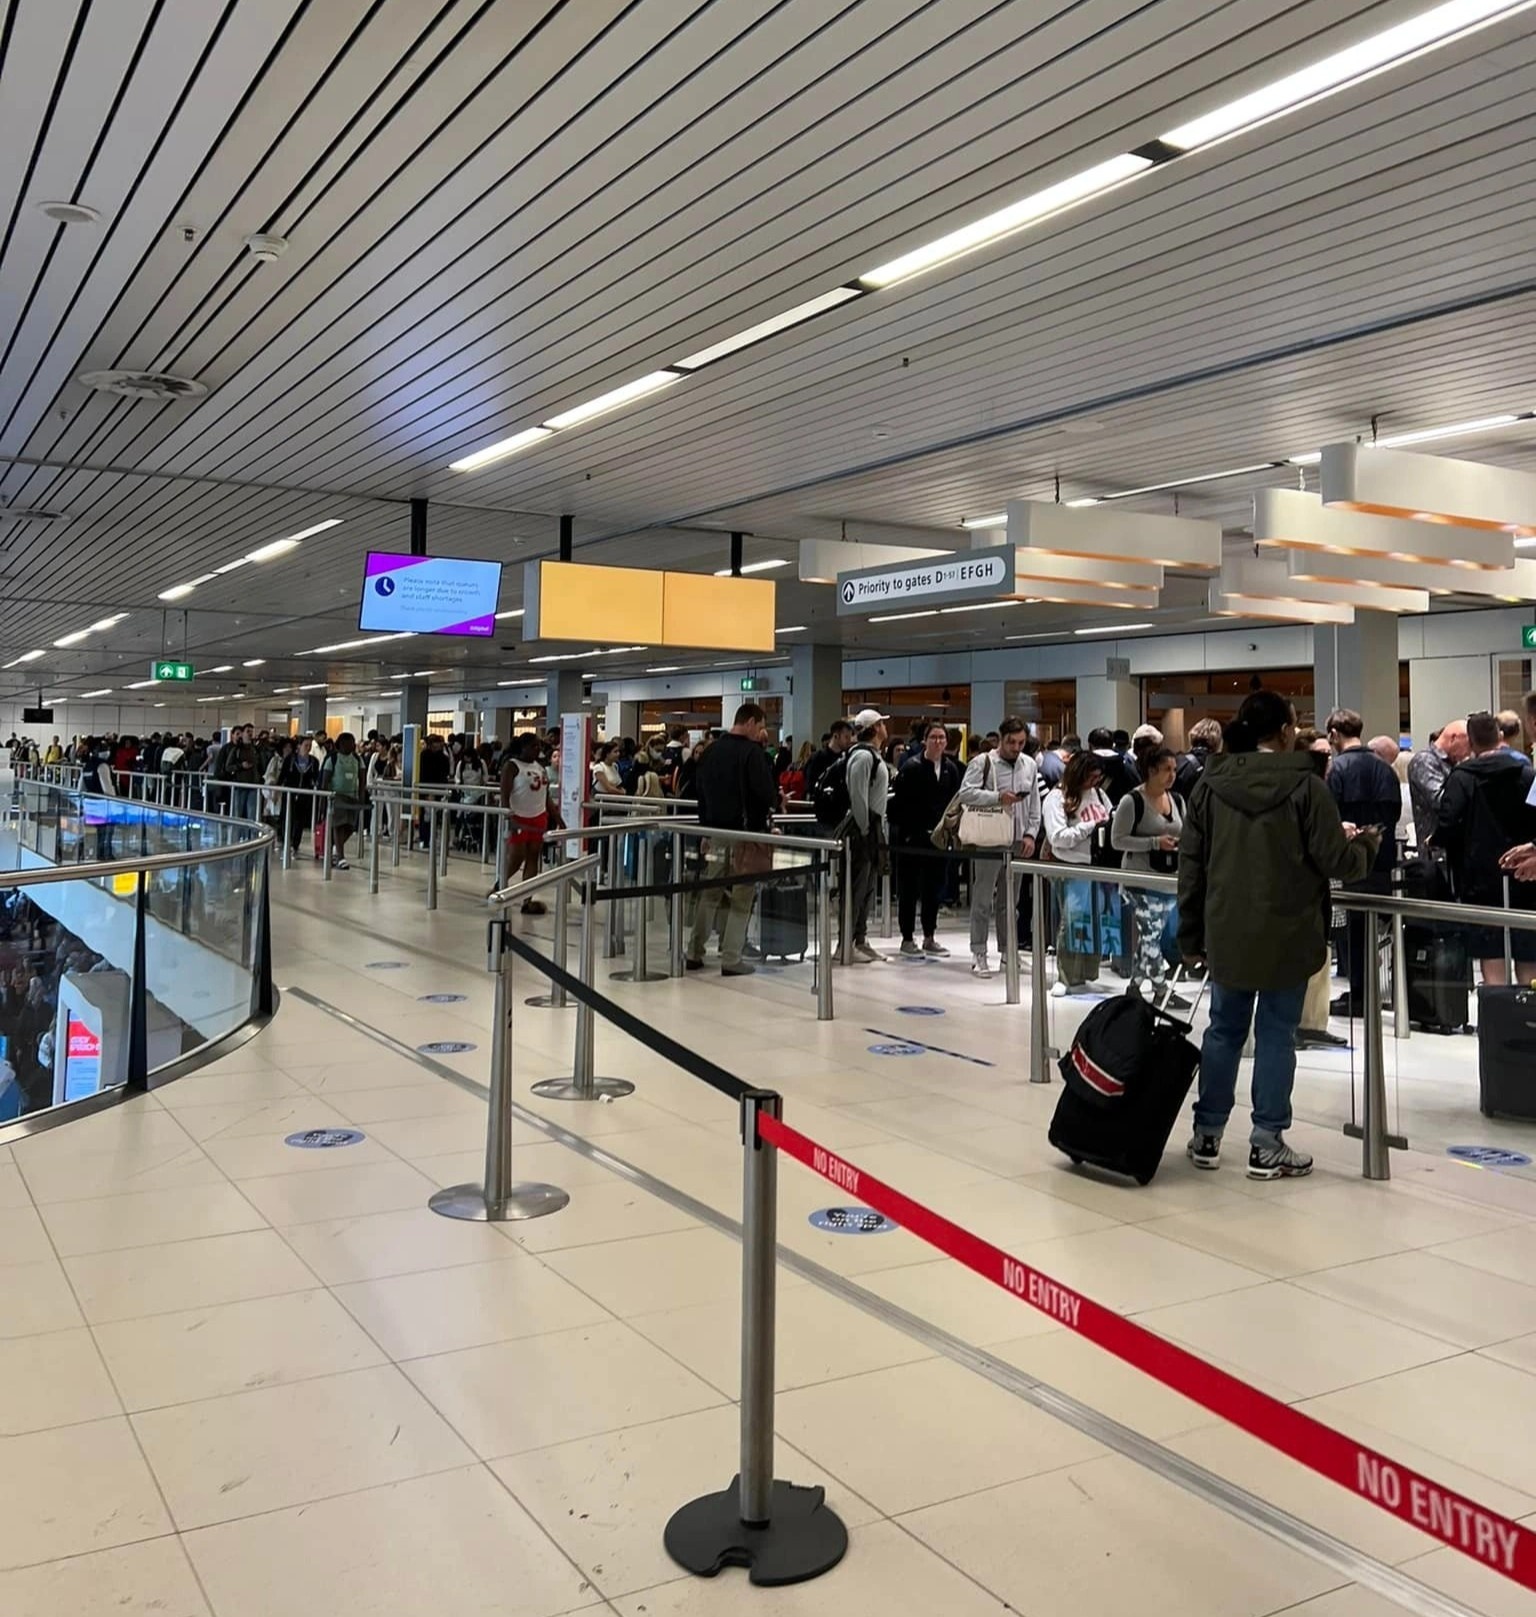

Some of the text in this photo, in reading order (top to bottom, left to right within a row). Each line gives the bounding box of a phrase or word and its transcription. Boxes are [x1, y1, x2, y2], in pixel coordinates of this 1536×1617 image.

[858, 581, 890, 595] Priority
[893, 578, 902, 590] to
[905, 574, 931, 591] gates
[814, 1147, 860, 1193] NO ENTRY
[1003, 1258, 1081, 1327] NO ENTRY
[1357, 1452, 1520, 1570] NO ENTRY
